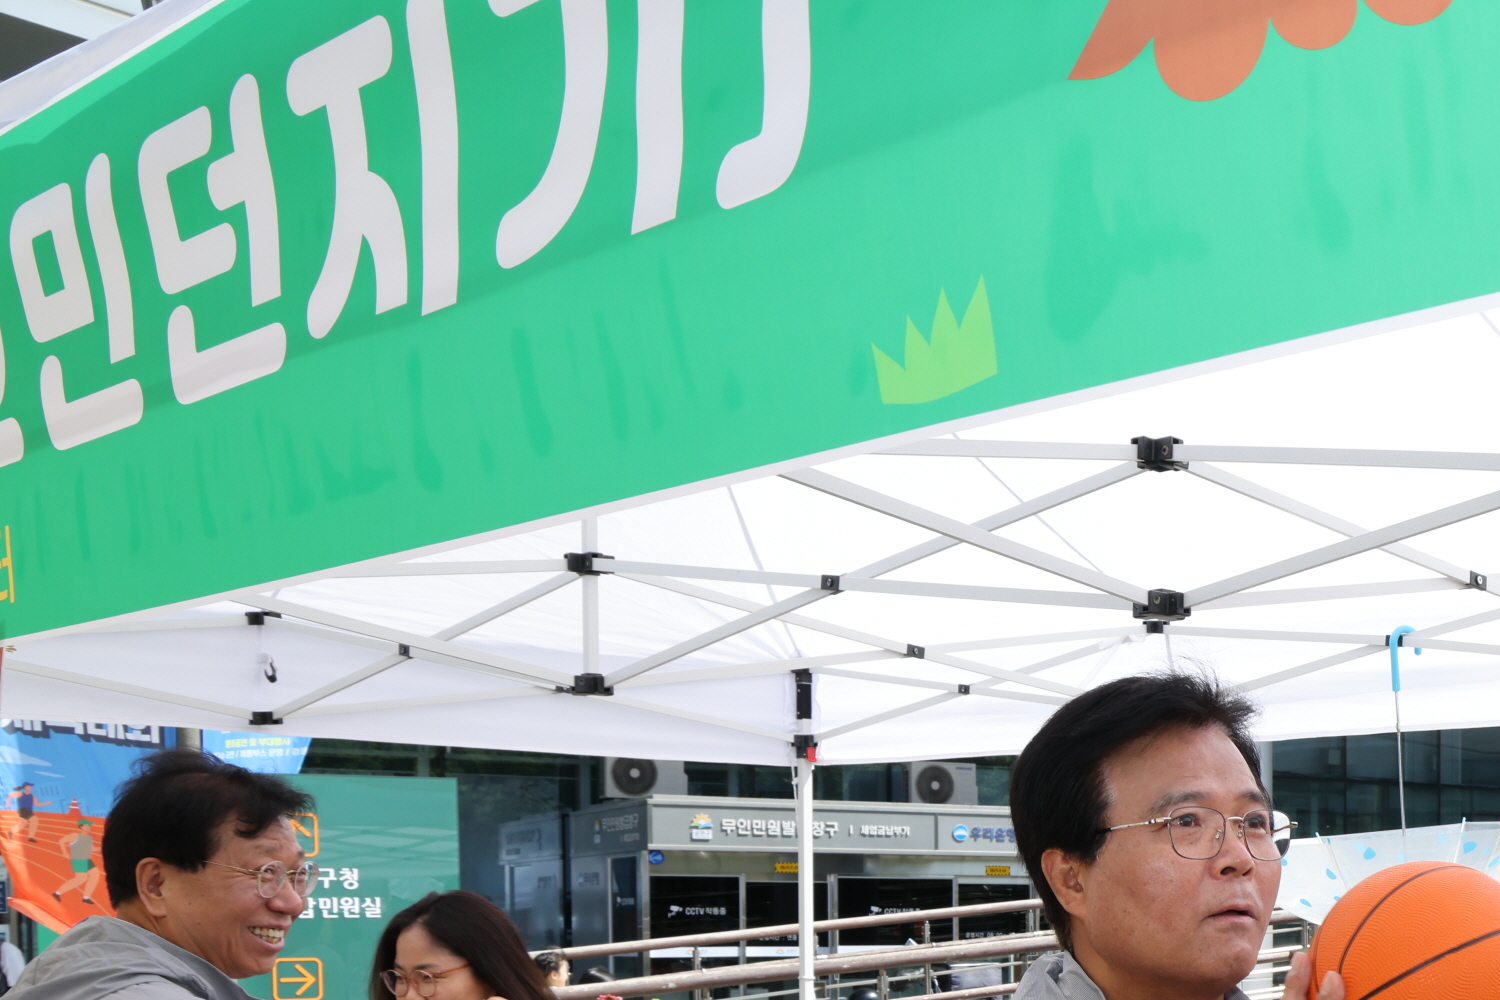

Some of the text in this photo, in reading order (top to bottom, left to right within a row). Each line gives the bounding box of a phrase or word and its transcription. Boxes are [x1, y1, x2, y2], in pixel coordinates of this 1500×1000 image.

[721, 817, 839, 838] 무인민원발창구
[317, 867, 360, 890] 구청
[684, 906, 704, 916] CCTV
